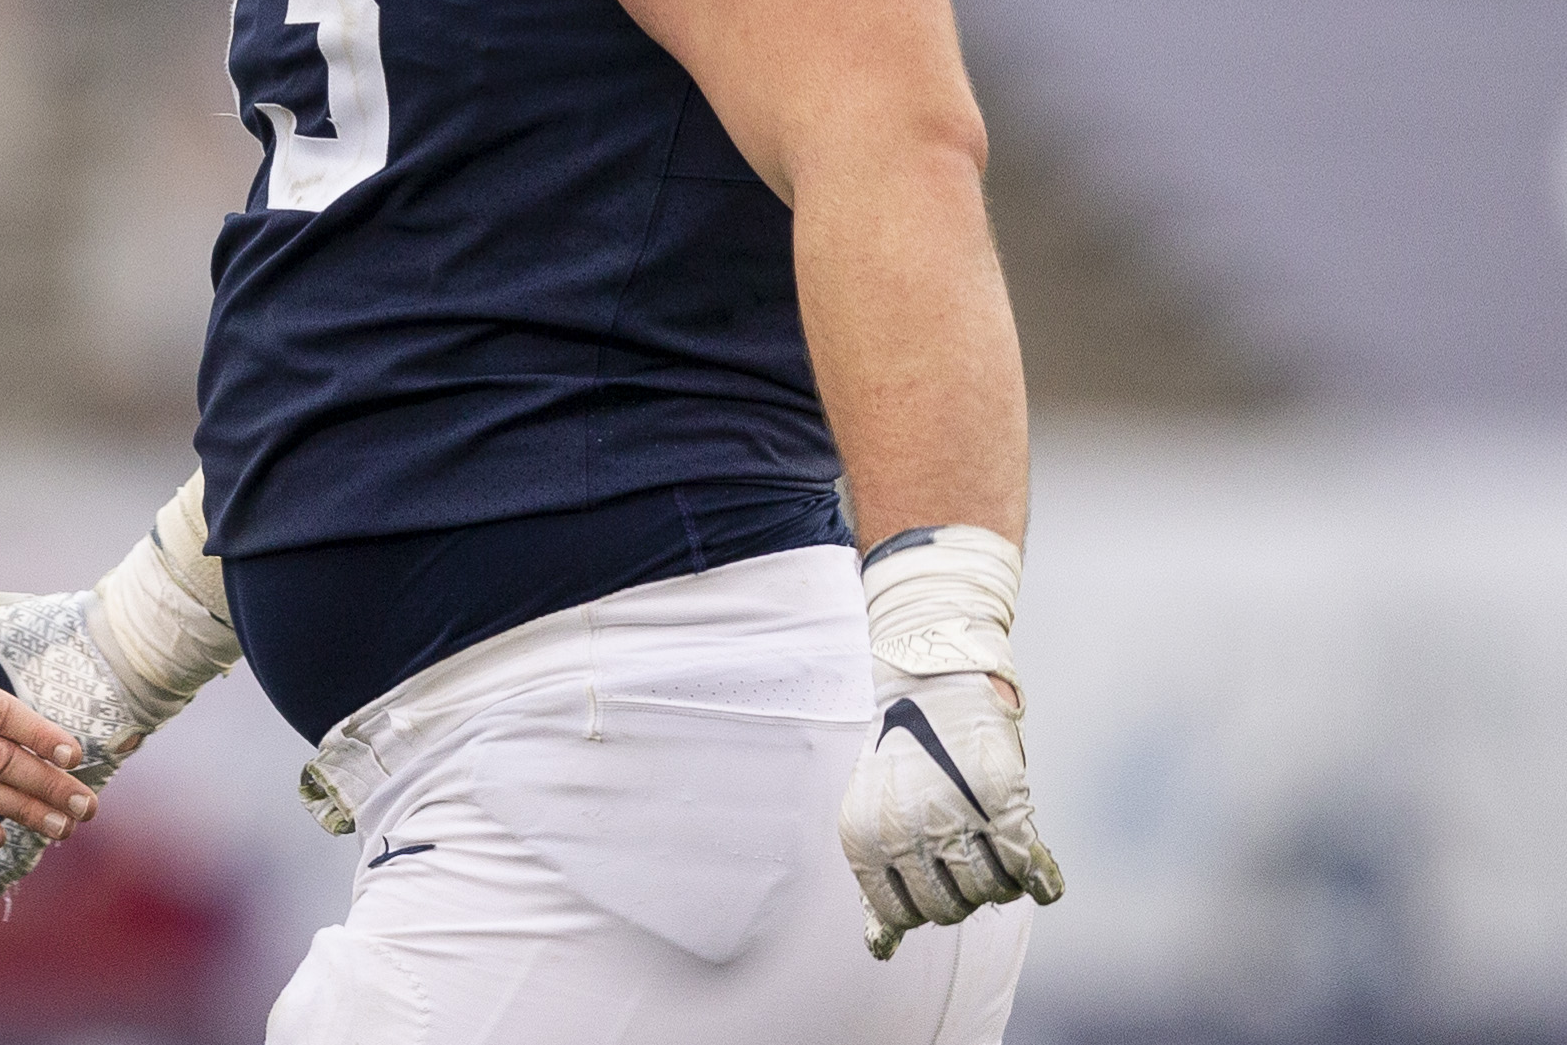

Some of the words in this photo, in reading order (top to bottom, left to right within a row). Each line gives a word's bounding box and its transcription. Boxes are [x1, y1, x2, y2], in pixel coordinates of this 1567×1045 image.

[7, 628, 48, 655] ARE
[51, 667, 98, 694] ARE
[51, 686, 90, 712] WE
